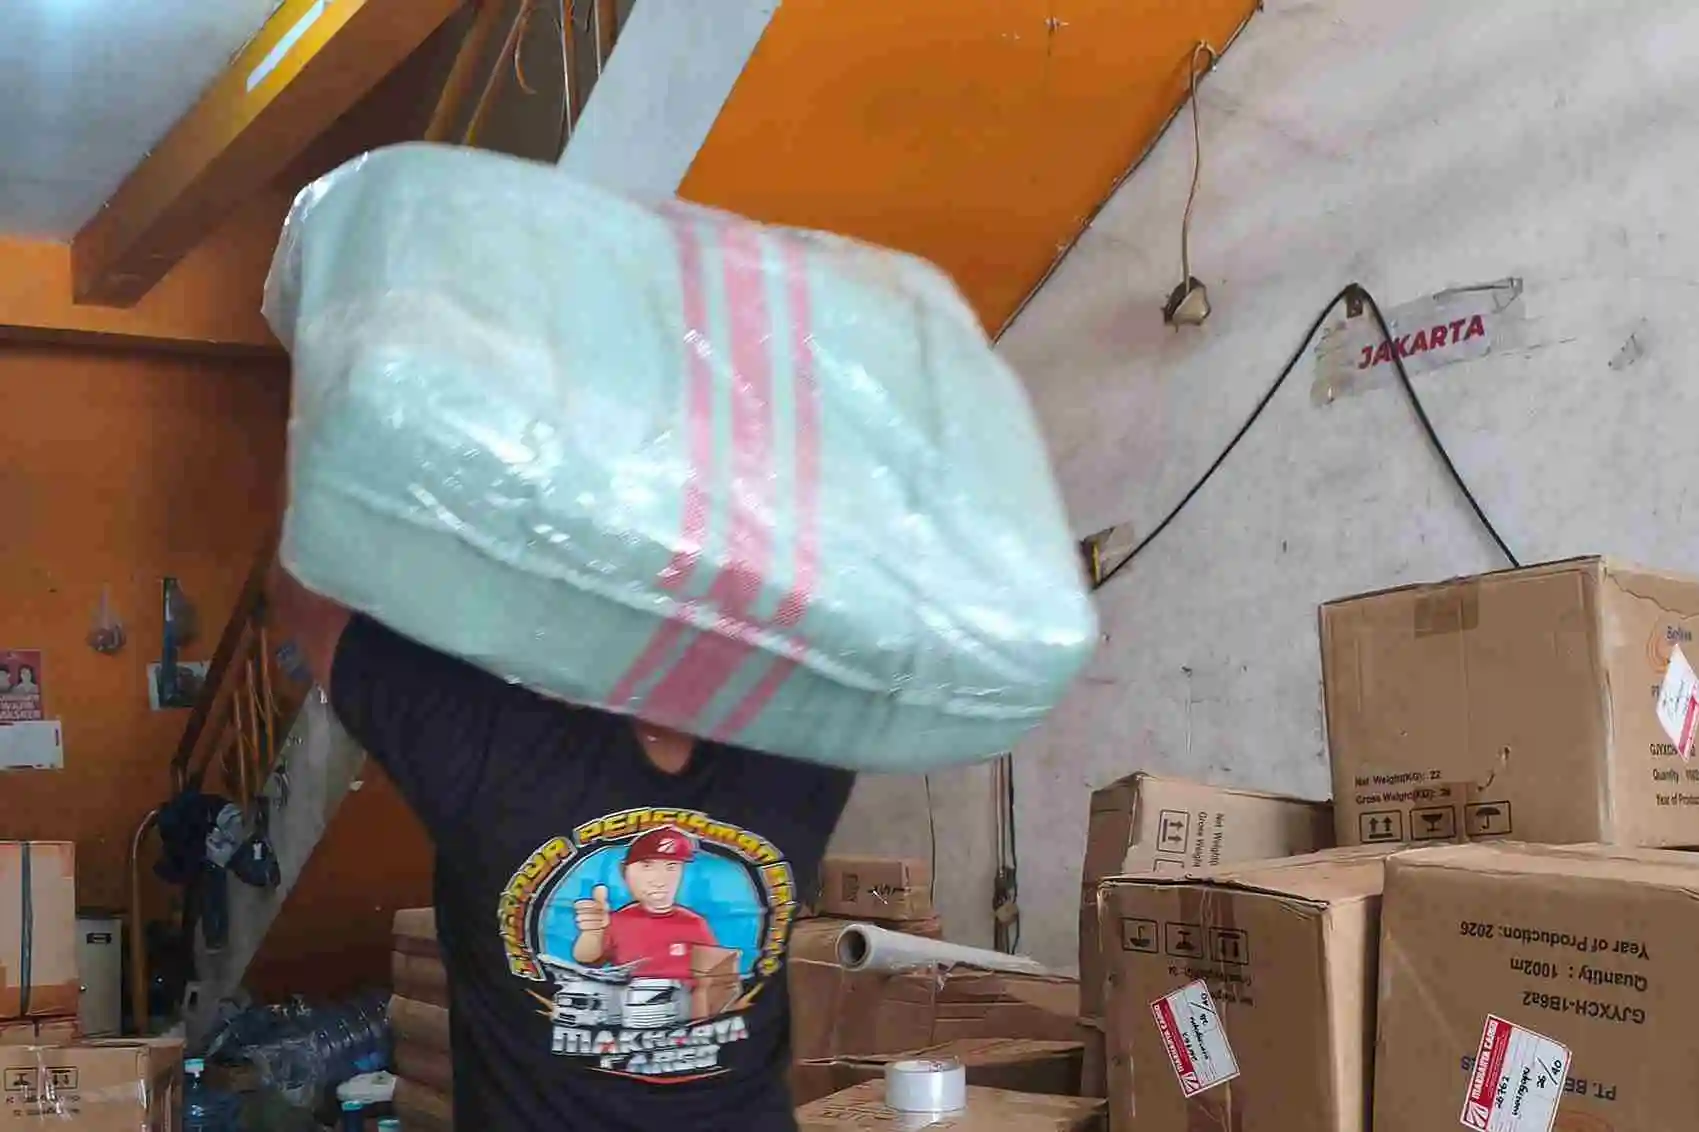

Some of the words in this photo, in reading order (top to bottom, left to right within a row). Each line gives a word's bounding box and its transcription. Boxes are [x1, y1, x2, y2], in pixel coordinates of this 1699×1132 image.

[1358, 314, 1485, 370] JAKARTA
[1459, 920, 1494, 939] 2026
[1499, 925, 1589, 952] Production:
[1592, 937, 1609, 953] of
[1612, 940, 1650, 961] Year
[1578, 964, 1648, 992] Quantity
[1592, 1082, 1617, 1101] PT.
